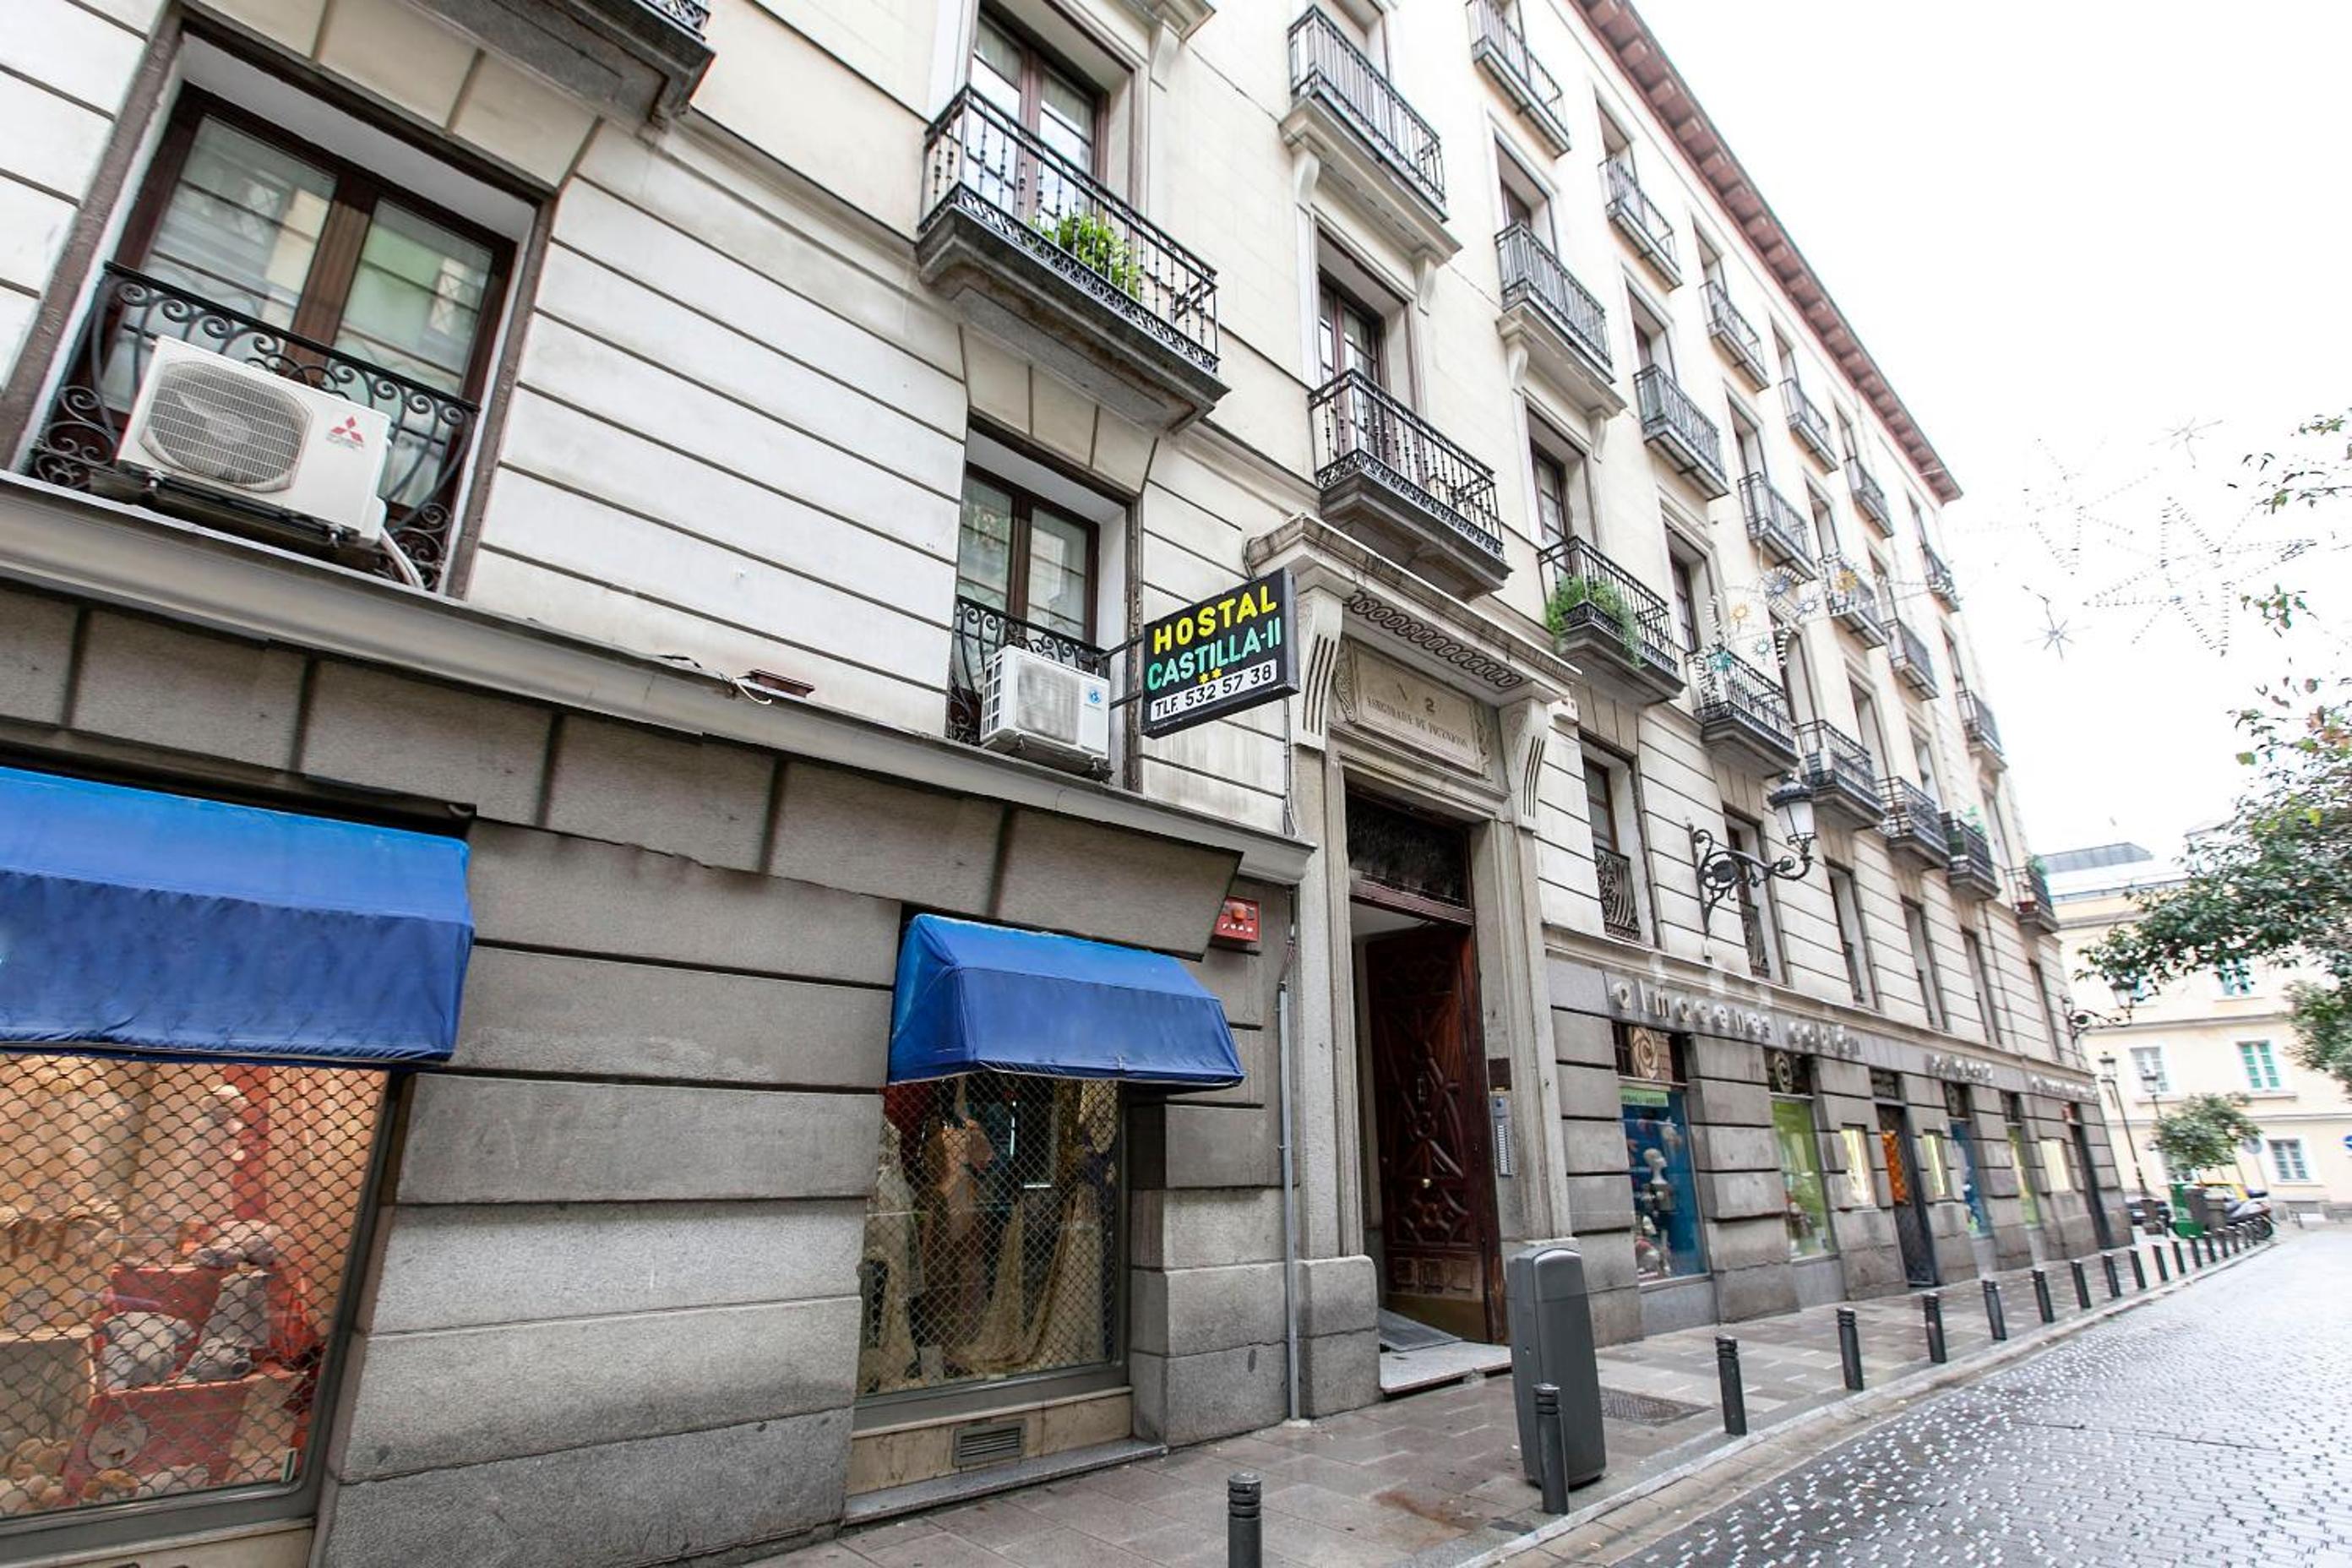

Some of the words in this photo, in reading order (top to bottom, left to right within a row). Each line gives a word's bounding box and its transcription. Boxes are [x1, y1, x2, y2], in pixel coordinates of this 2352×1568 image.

[1146, 616, 1282, 691] CASTILLA-II
[1153, 585, 1277, 655] HOSTAL
[1184, 680, 1217, 706] 532
[1222, 675, 1244, 694] 57
[1250, 663, 1271, 685] 38
